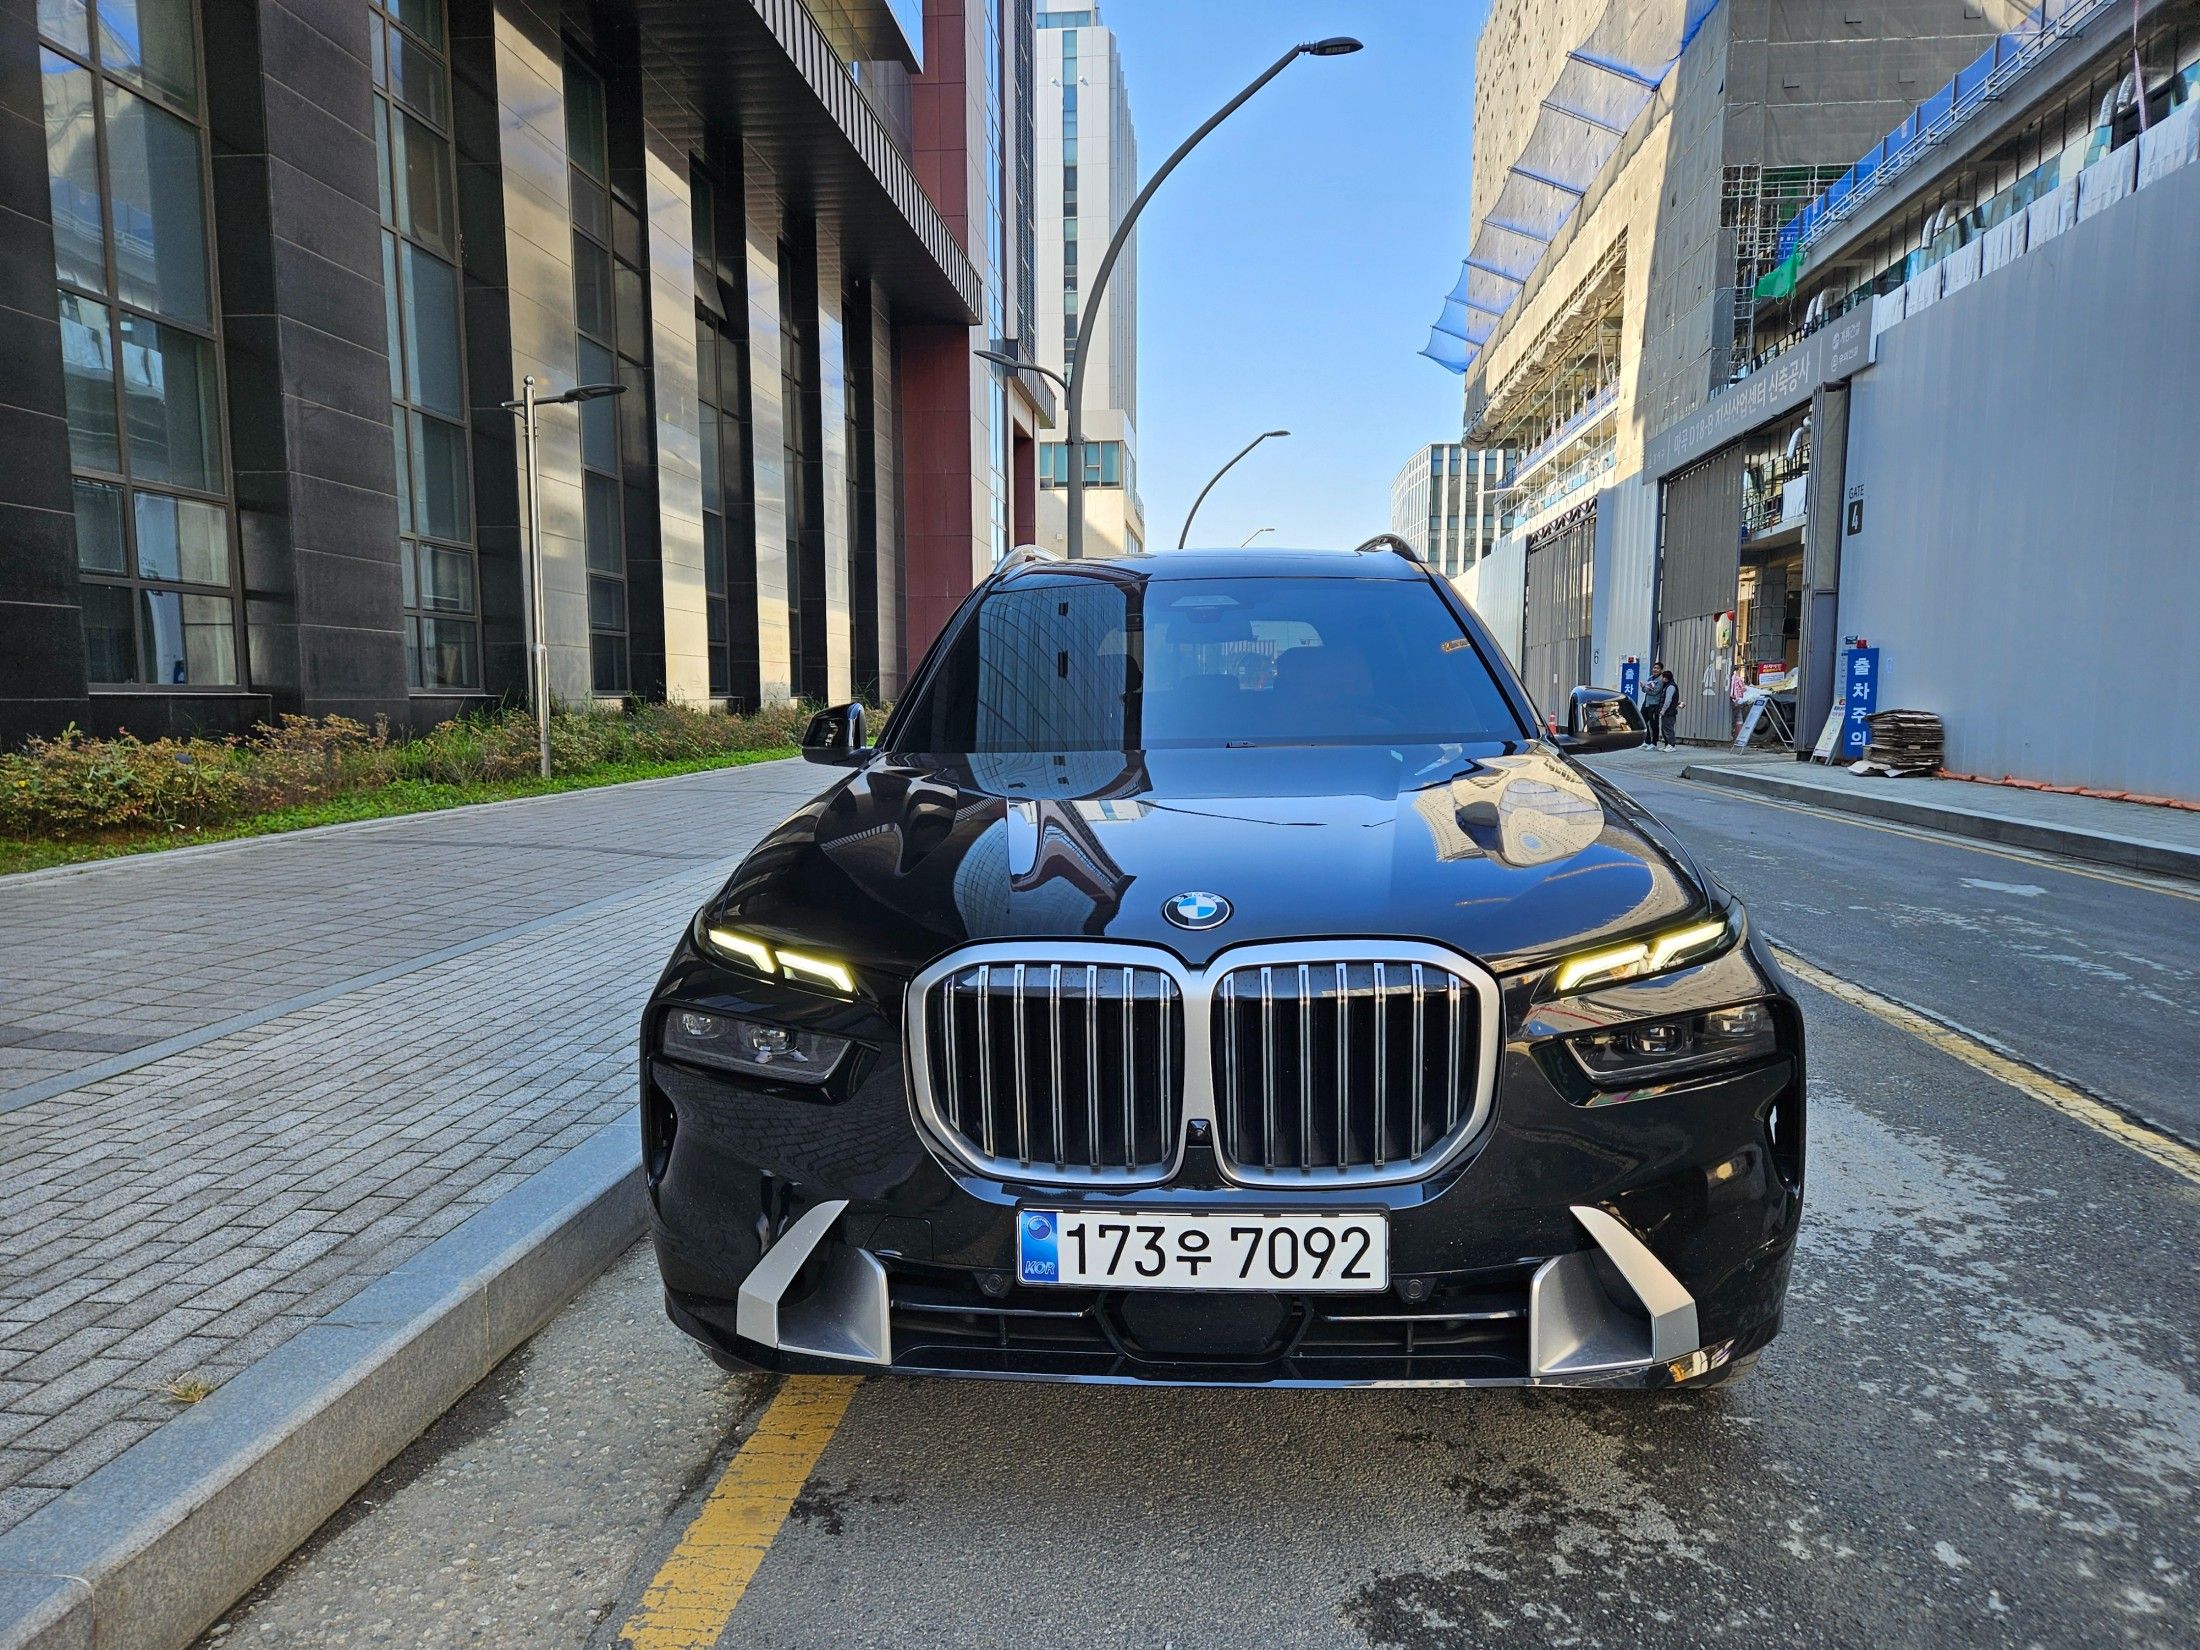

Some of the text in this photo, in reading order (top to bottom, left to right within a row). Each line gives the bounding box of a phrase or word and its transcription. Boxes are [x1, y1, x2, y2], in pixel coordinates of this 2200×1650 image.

[1674, 352, 1811, 456] 마곡 D18-B 지식산업센터 신축공사
[1848, 483, 1865, 500] GATE
[1851, 503, 1860, 531] 4
[1066, 1222, 1371, 1279] 173우 7092
[1024, 1260, 1055, 1275] KOR
